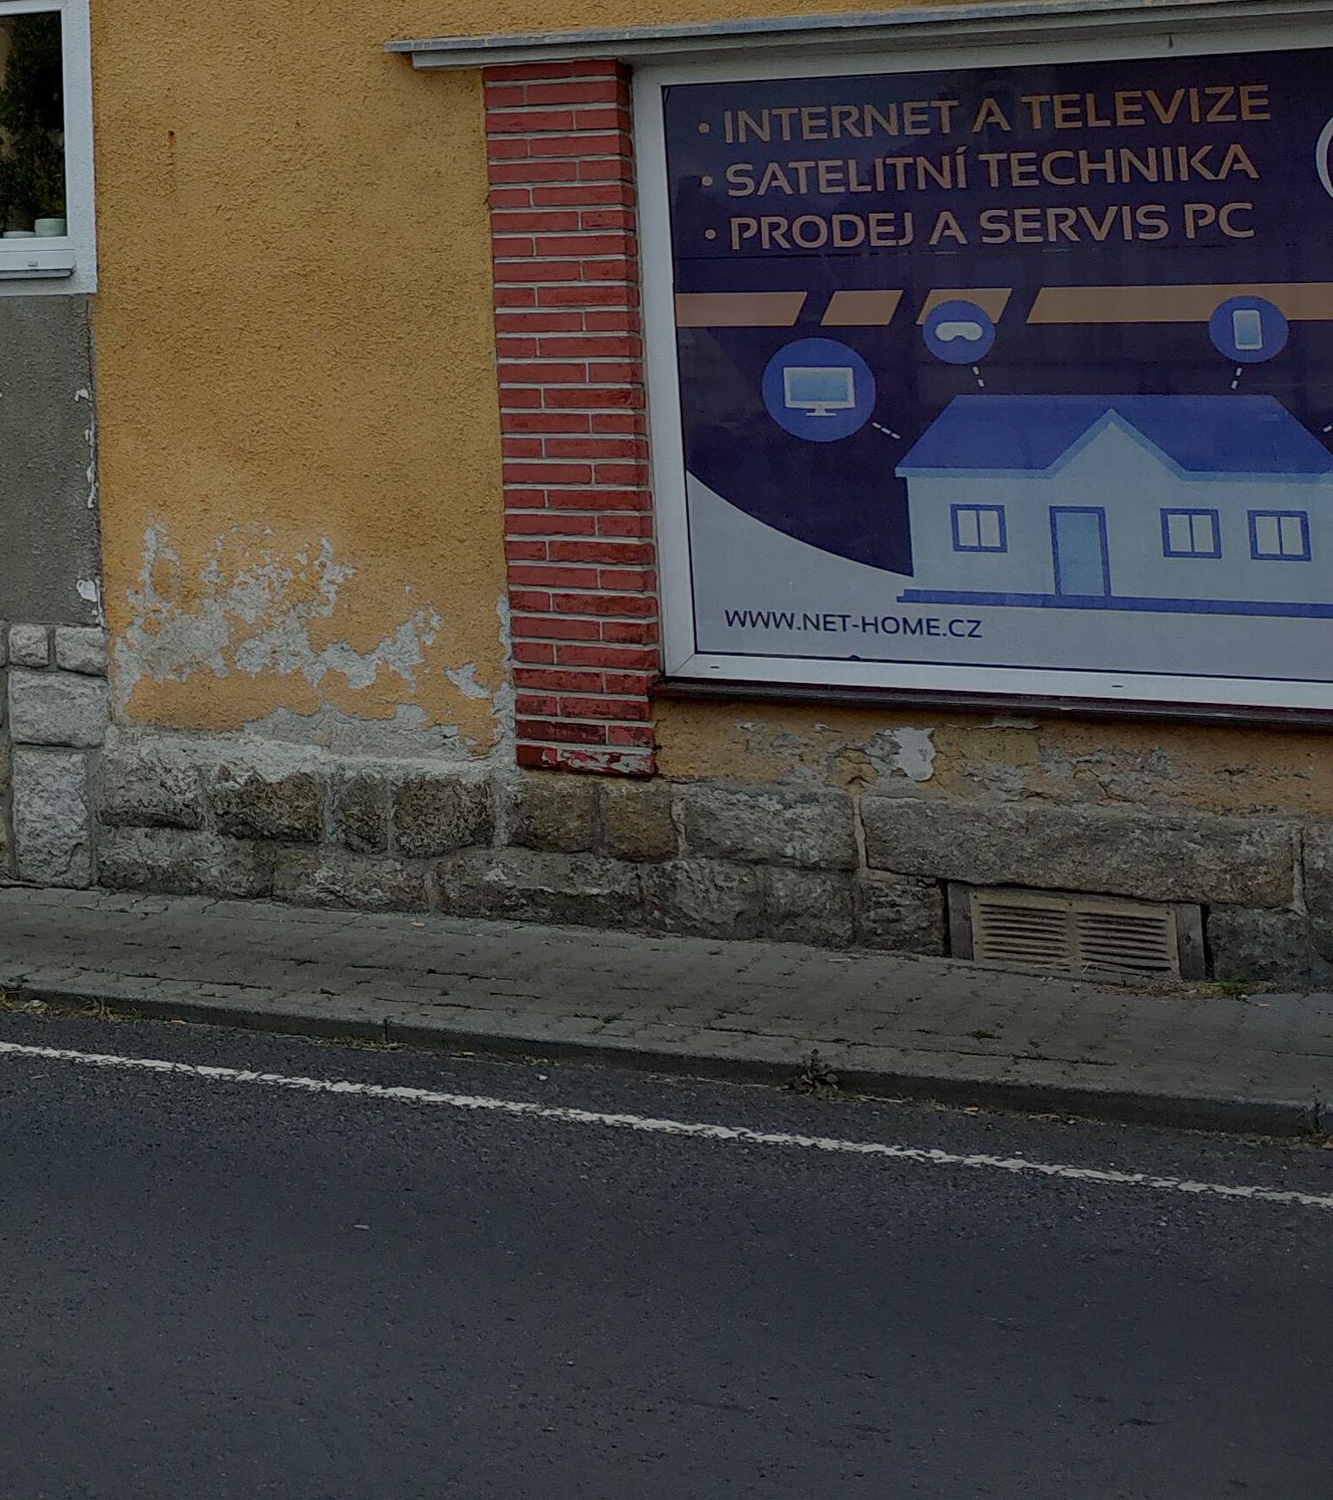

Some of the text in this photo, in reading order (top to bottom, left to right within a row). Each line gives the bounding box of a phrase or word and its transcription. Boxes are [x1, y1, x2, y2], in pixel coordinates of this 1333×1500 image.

[723, 84, 1272, 145] INTERNET A TELEVIZE
[726, 144, 1259, 197] SATELITNÍ TECHNIKA
[730, 202, 1256, 251] PRODEJ A SERVIS PC
[724, 608, 984, 639] WWW.NET-HOME.CZ
